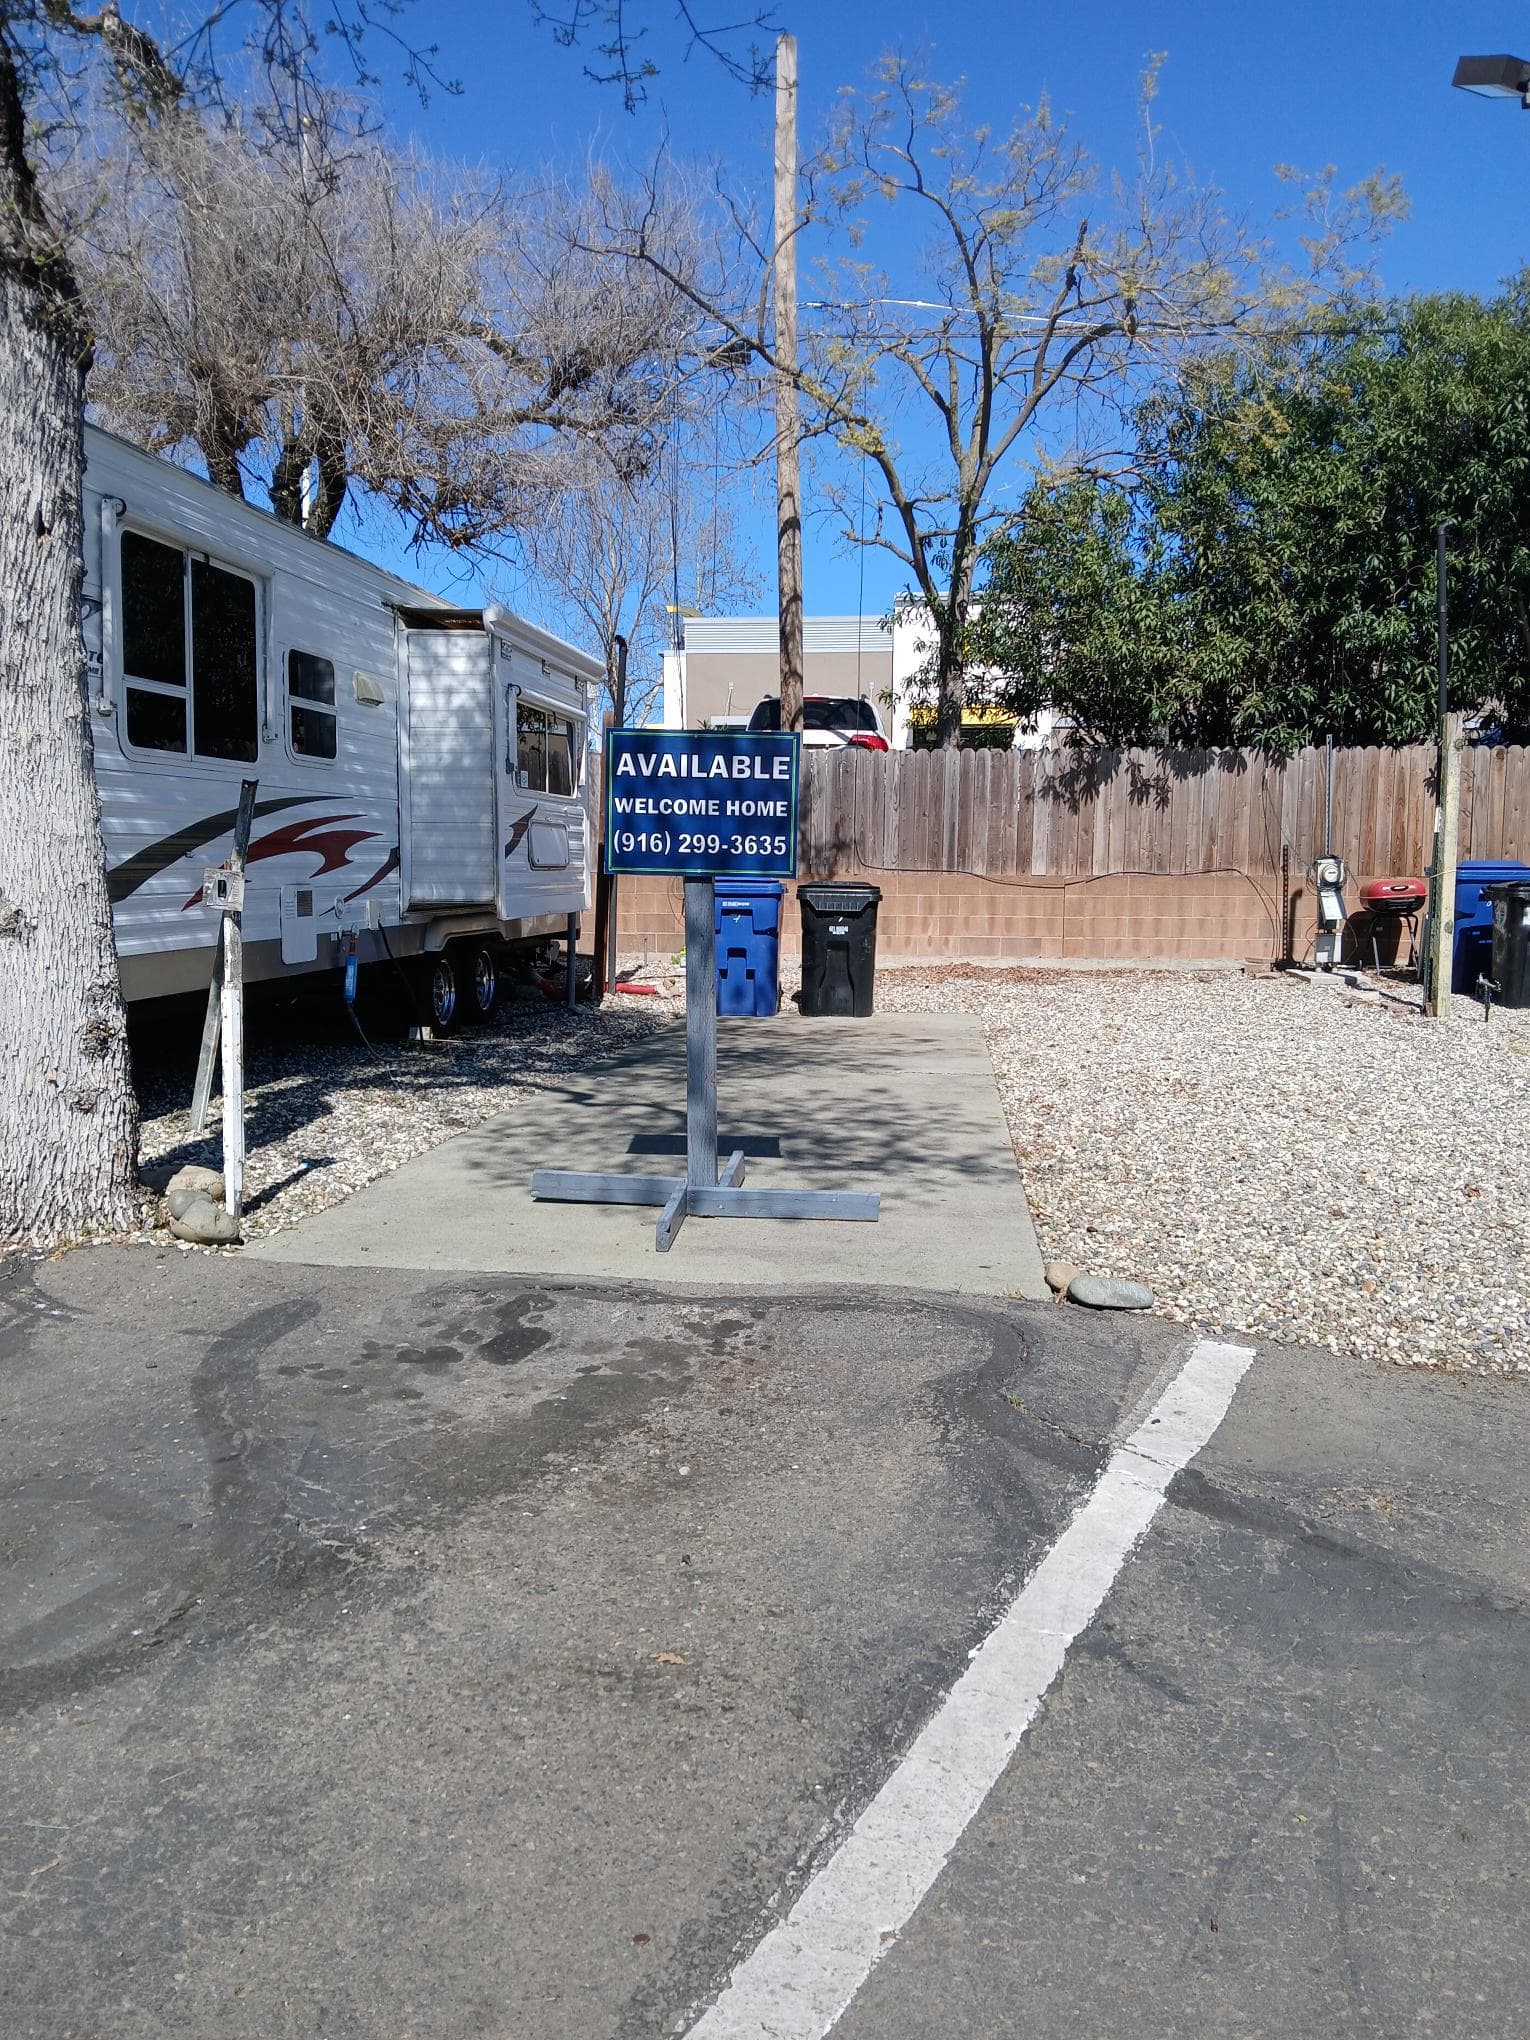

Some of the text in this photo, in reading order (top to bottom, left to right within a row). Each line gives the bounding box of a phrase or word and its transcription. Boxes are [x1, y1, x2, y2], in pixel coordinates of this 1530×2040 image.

[615, 752, 791, 780] AVAILABLE
[614, 797, 788, 817] WELCOME HOME
[613, 829, 787, 856] (916) 299-3635
